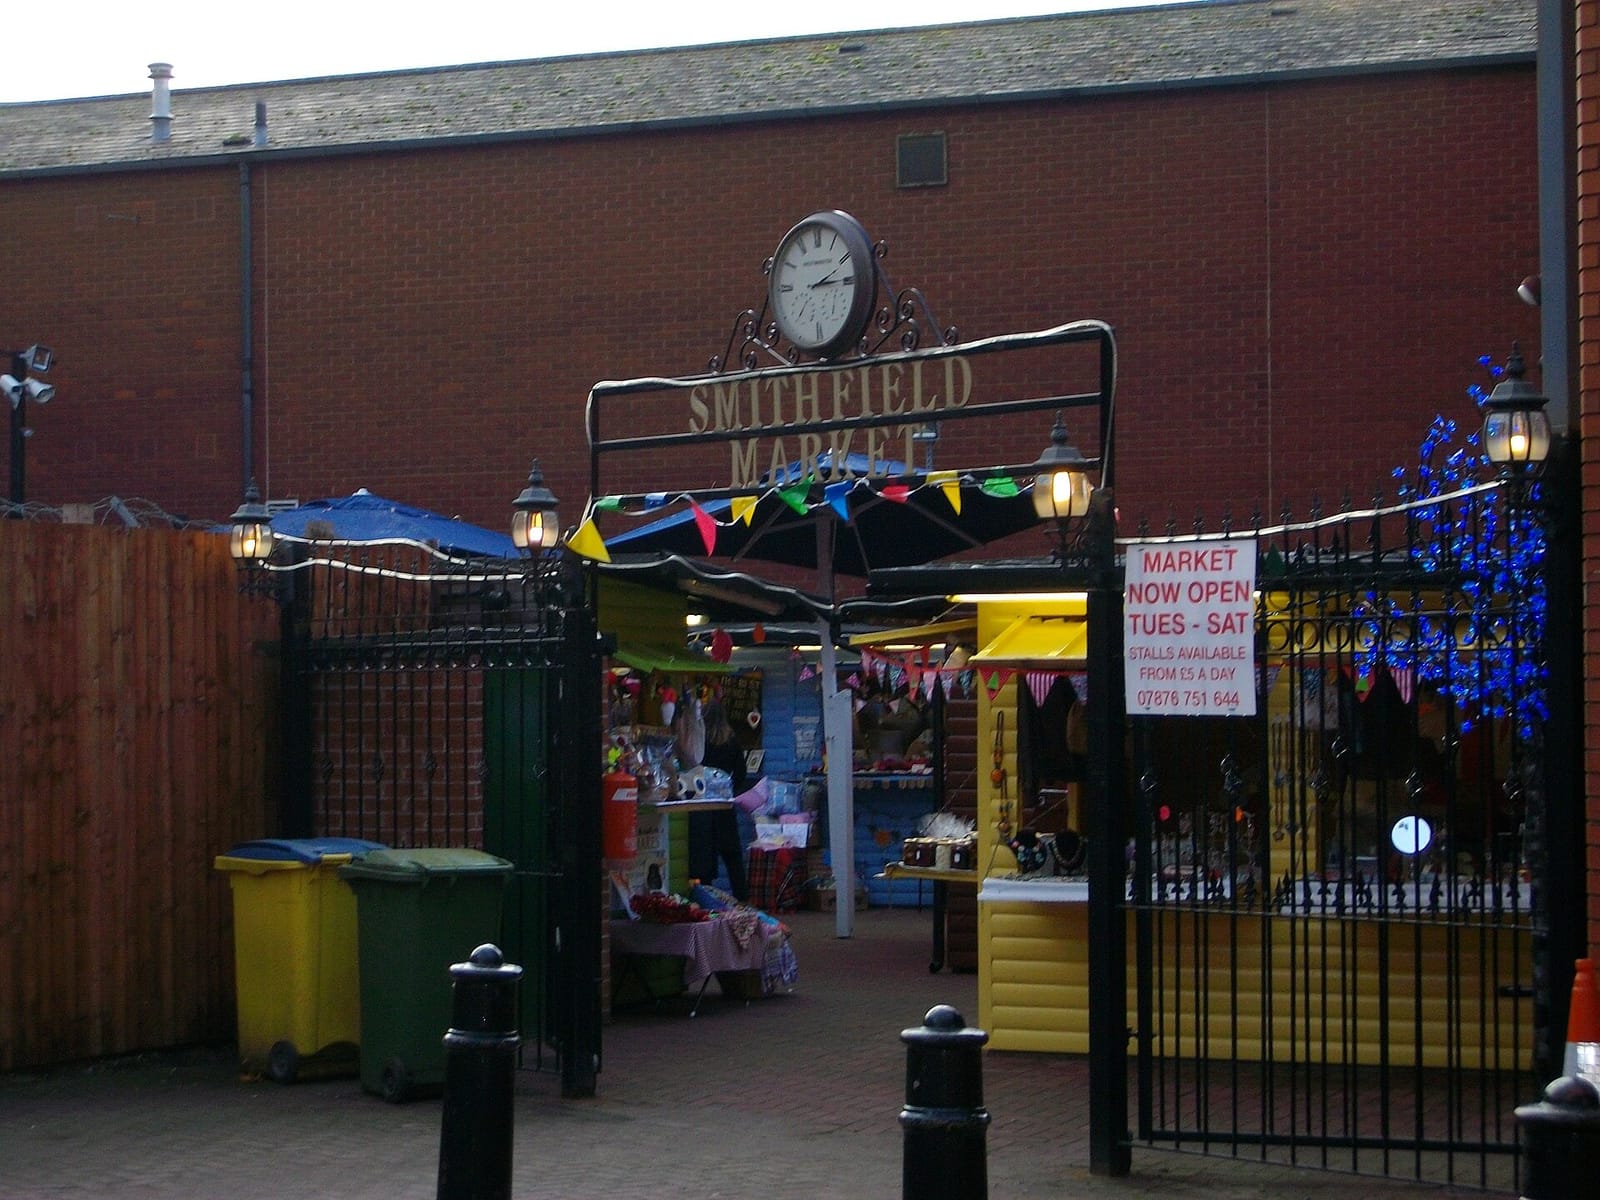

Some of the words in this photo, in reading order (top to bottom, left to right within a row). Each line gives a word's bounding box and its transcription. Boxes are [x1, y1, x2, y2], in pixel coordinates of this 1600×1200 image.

[689, 354, 972, 435] SMITHFIELD
[729, 421, 918, 489] MARKET
[1143, 549, 1237, 573] MARKET
[1128, 582, 1181, 604] NOW
[1188, 580, 1250, 603] OPEN
[1129, 613, 1185, 635] TUES
[1207, 612, 1249, 634] SAT
[1129, 647, 1174, 660] STALLS
[1178, 646, 1246, 660] AVAILABLE
[1140, 667, 1176, 681] FROM
[1180, 667, 1194, 681] £5
[1198, 667, 1207, 680] A
[1211, 667, 1236, 680] DAY
[1184, 690, 1208, 706] 751
[1213, 690, 1240, 706] 644
